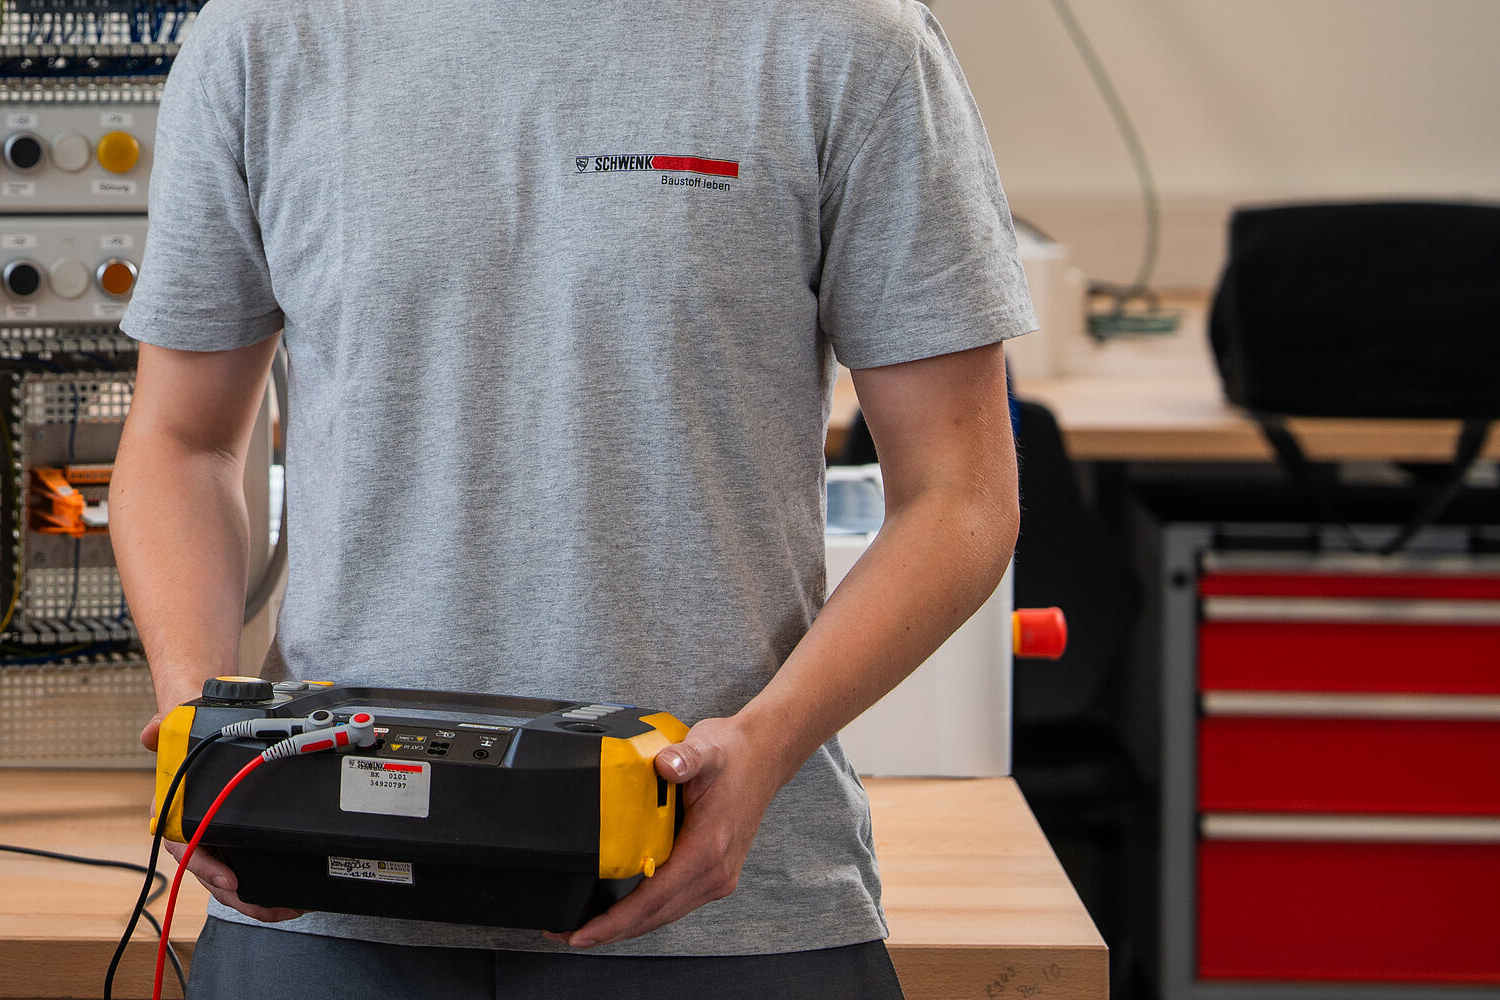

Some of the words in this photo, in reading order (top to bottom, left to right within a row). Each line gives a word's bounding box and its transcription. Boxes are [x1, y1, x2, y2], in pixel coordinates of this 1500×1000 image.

[595, 155, 653, 171] SCHWENK
[661, 175, 702, 188] Baustoff
[703, 178, 731, 191] leben
[388, 772, 407, 781] 0101
[370, 779, 407, 789] 34920797
